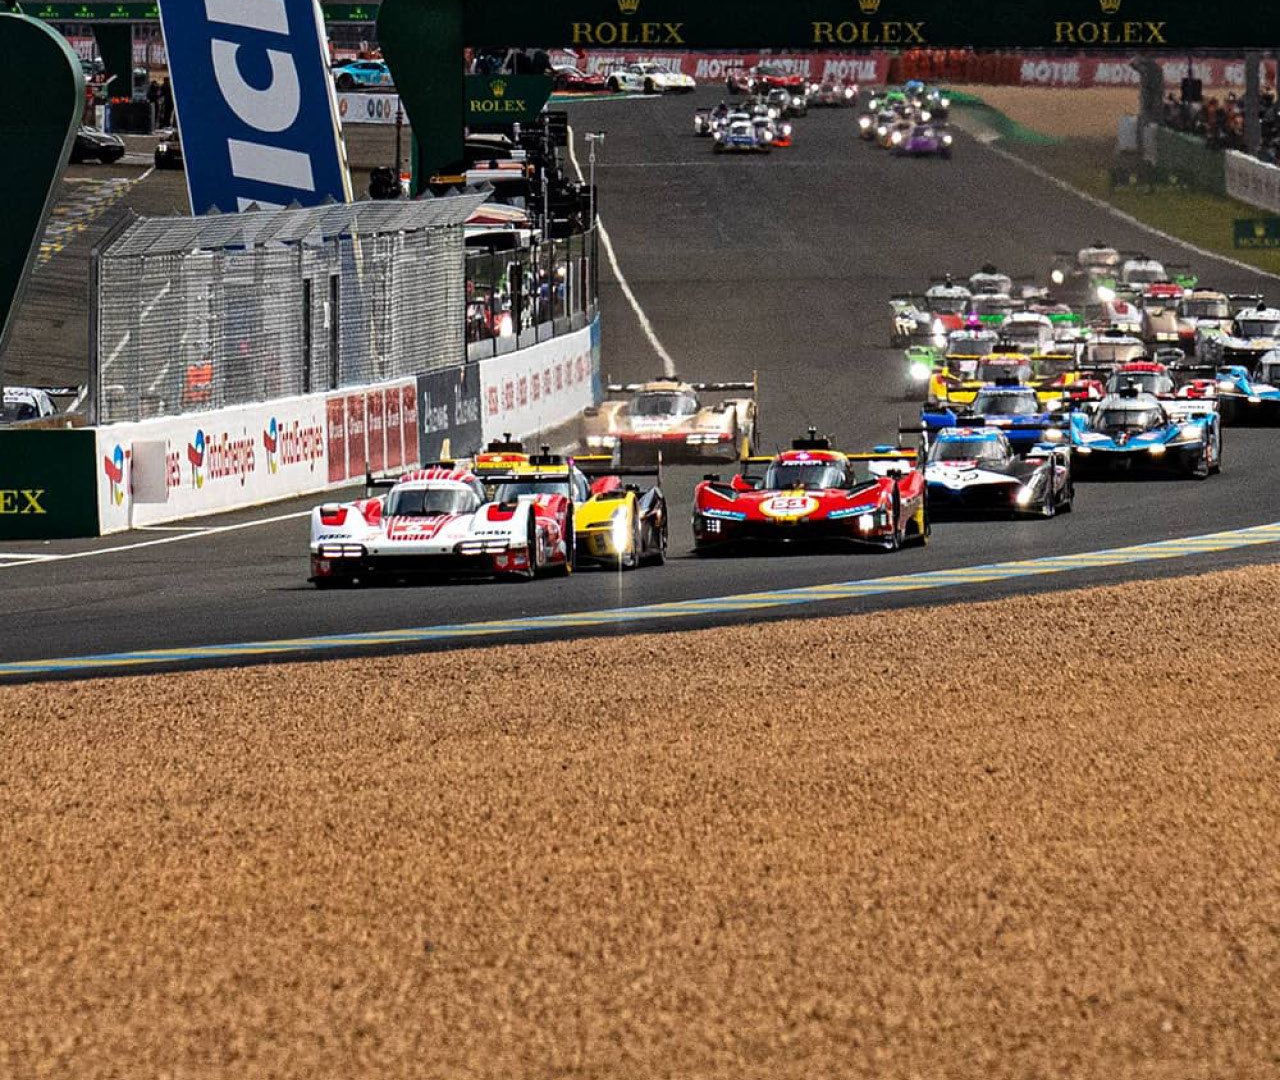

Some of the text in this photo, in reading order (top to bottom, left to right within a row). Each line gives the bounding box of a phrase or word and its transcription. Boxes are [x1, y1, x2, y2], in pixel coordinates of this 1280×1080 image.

[572, 22, 685, 44] ROLEX
[812, 22, 927, 43] ROLEX
[1054, 21, 1167, 43] ROLEX
[822, 60, 877, 80] MOTUL
[470, 100, 526, 112] ROLEX
